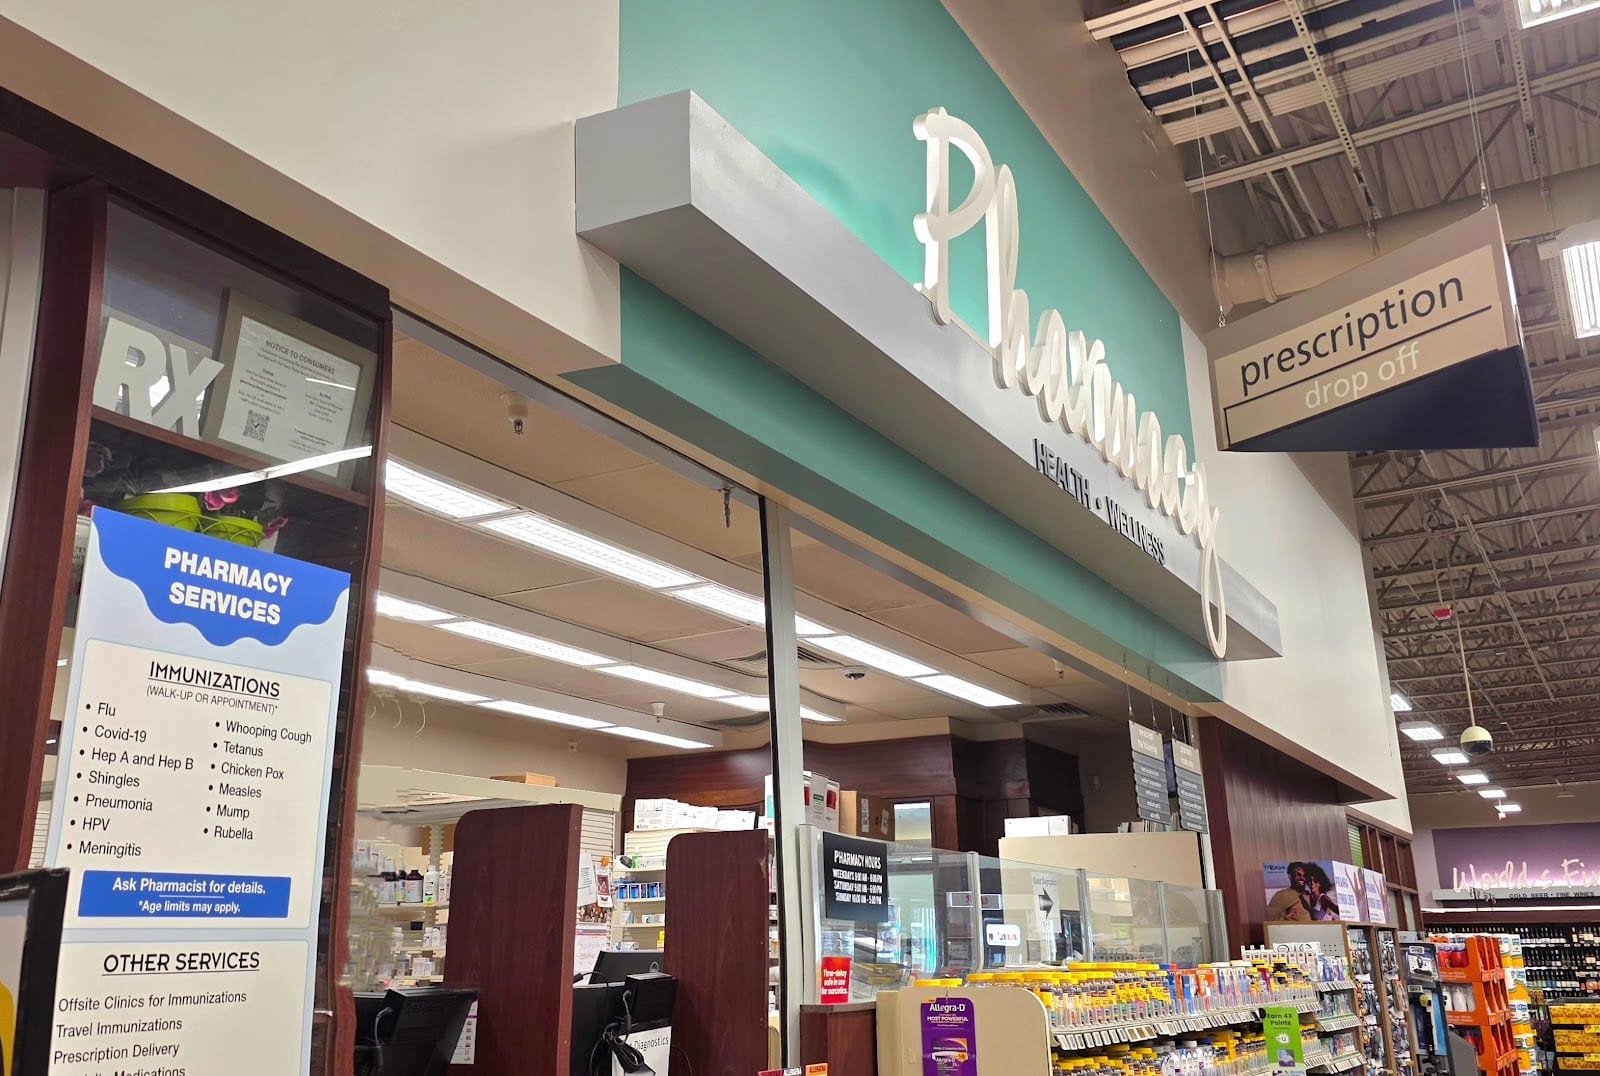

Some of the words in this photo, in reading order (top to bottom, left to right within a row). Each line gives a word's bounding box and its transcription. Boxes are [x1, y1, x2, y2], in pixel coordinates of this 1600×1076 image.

[1240, 276, 1463, 396] prescription
[265, 340, 289, 355] NOTICE
[290, 350, 299, 360] TO
[299, 353, 336, 375] CONSUMERS
[914, 107, 1227, 658] Pharmacy
[1305, 370, 1368, 408] drop
[1378, 341, 1420, 381] off
[1033, 438, 1092, 510] HEALTH
[1105, 496, 1166, 566] WELLNESS
[164, 547, 292, 597] PHARMACY
[169, 582, 281, 625] SERVICES
[149, 661, 280, 696] IMMUNIZATIONS
[146, 685, 193, 701] (WALK-UP
[195, 692, 209, 703] OR
[97, 702, 116, 717] Flu
[94, 725, 147, 743] Covid-19
[225, 720, 277, 741] Whooping
[280, 728, 312, 744] Cough
[223, 740, 264, 757] Tetanus
[91, 748, 116, 765] Hep
[119, 752, 129, 764] A
[132, 753, 155, 767] and
[157, 757, 183, 772] Hep
[185, 758, 194, 770] B
[88, 771, 140, 789] Shingles
[221, 762, 262, 779] Chicken
[265, 767, 284, 781] Pox
[219, 783, 262, 799] Measles
[85, 794, 153, 812] Pneumonia
[216, 804, 250, 820] Mump
[82, 817, 110, 832] HPV
[214, 826, 253, 841] Rubella
[79, 840, 142, 857] Meningitis
[833, 850, 864, 868] PHARMACY
[865, 855, 882, 869] HOURS
[832, 868, 854, 881] WEEKDAYS
[112, 877, 137, 892] Ask
[139, 878, 207, 894] Pharmacist
[208, 879, 225, 894] for
[227, 880, 266, 894] details.
[834, 880, 854, 891] SATURDAY
[835, 892, 851, 902] SUNDAY
[164, 900, 190, 913] limits
[192, 903, 213, 915] may
[214, 902, 241, 915] apply.
[103, 954, 170, 973] OTHER
[175, 952, 260, 971] SERVICES
[58, 997, 100, 1012] Offsite
[104, 995, 144, 1009] Clinics
[148, 994, 165, 1008] for
[168, 991, 247, 1008] Immunizations
[929, 1003, 966, 1013] Allegra-D
[56, 1023, 93, 1039] Travel
[96, 1018, 183, 1036] Immunizations
[634, 1036, 669, 1052] Diagnostics
[53, 1045, 128, 1066] Prescription
[132, 1042, 180, 1060] Delivery
[114, 1067, 186, 1076] dications
